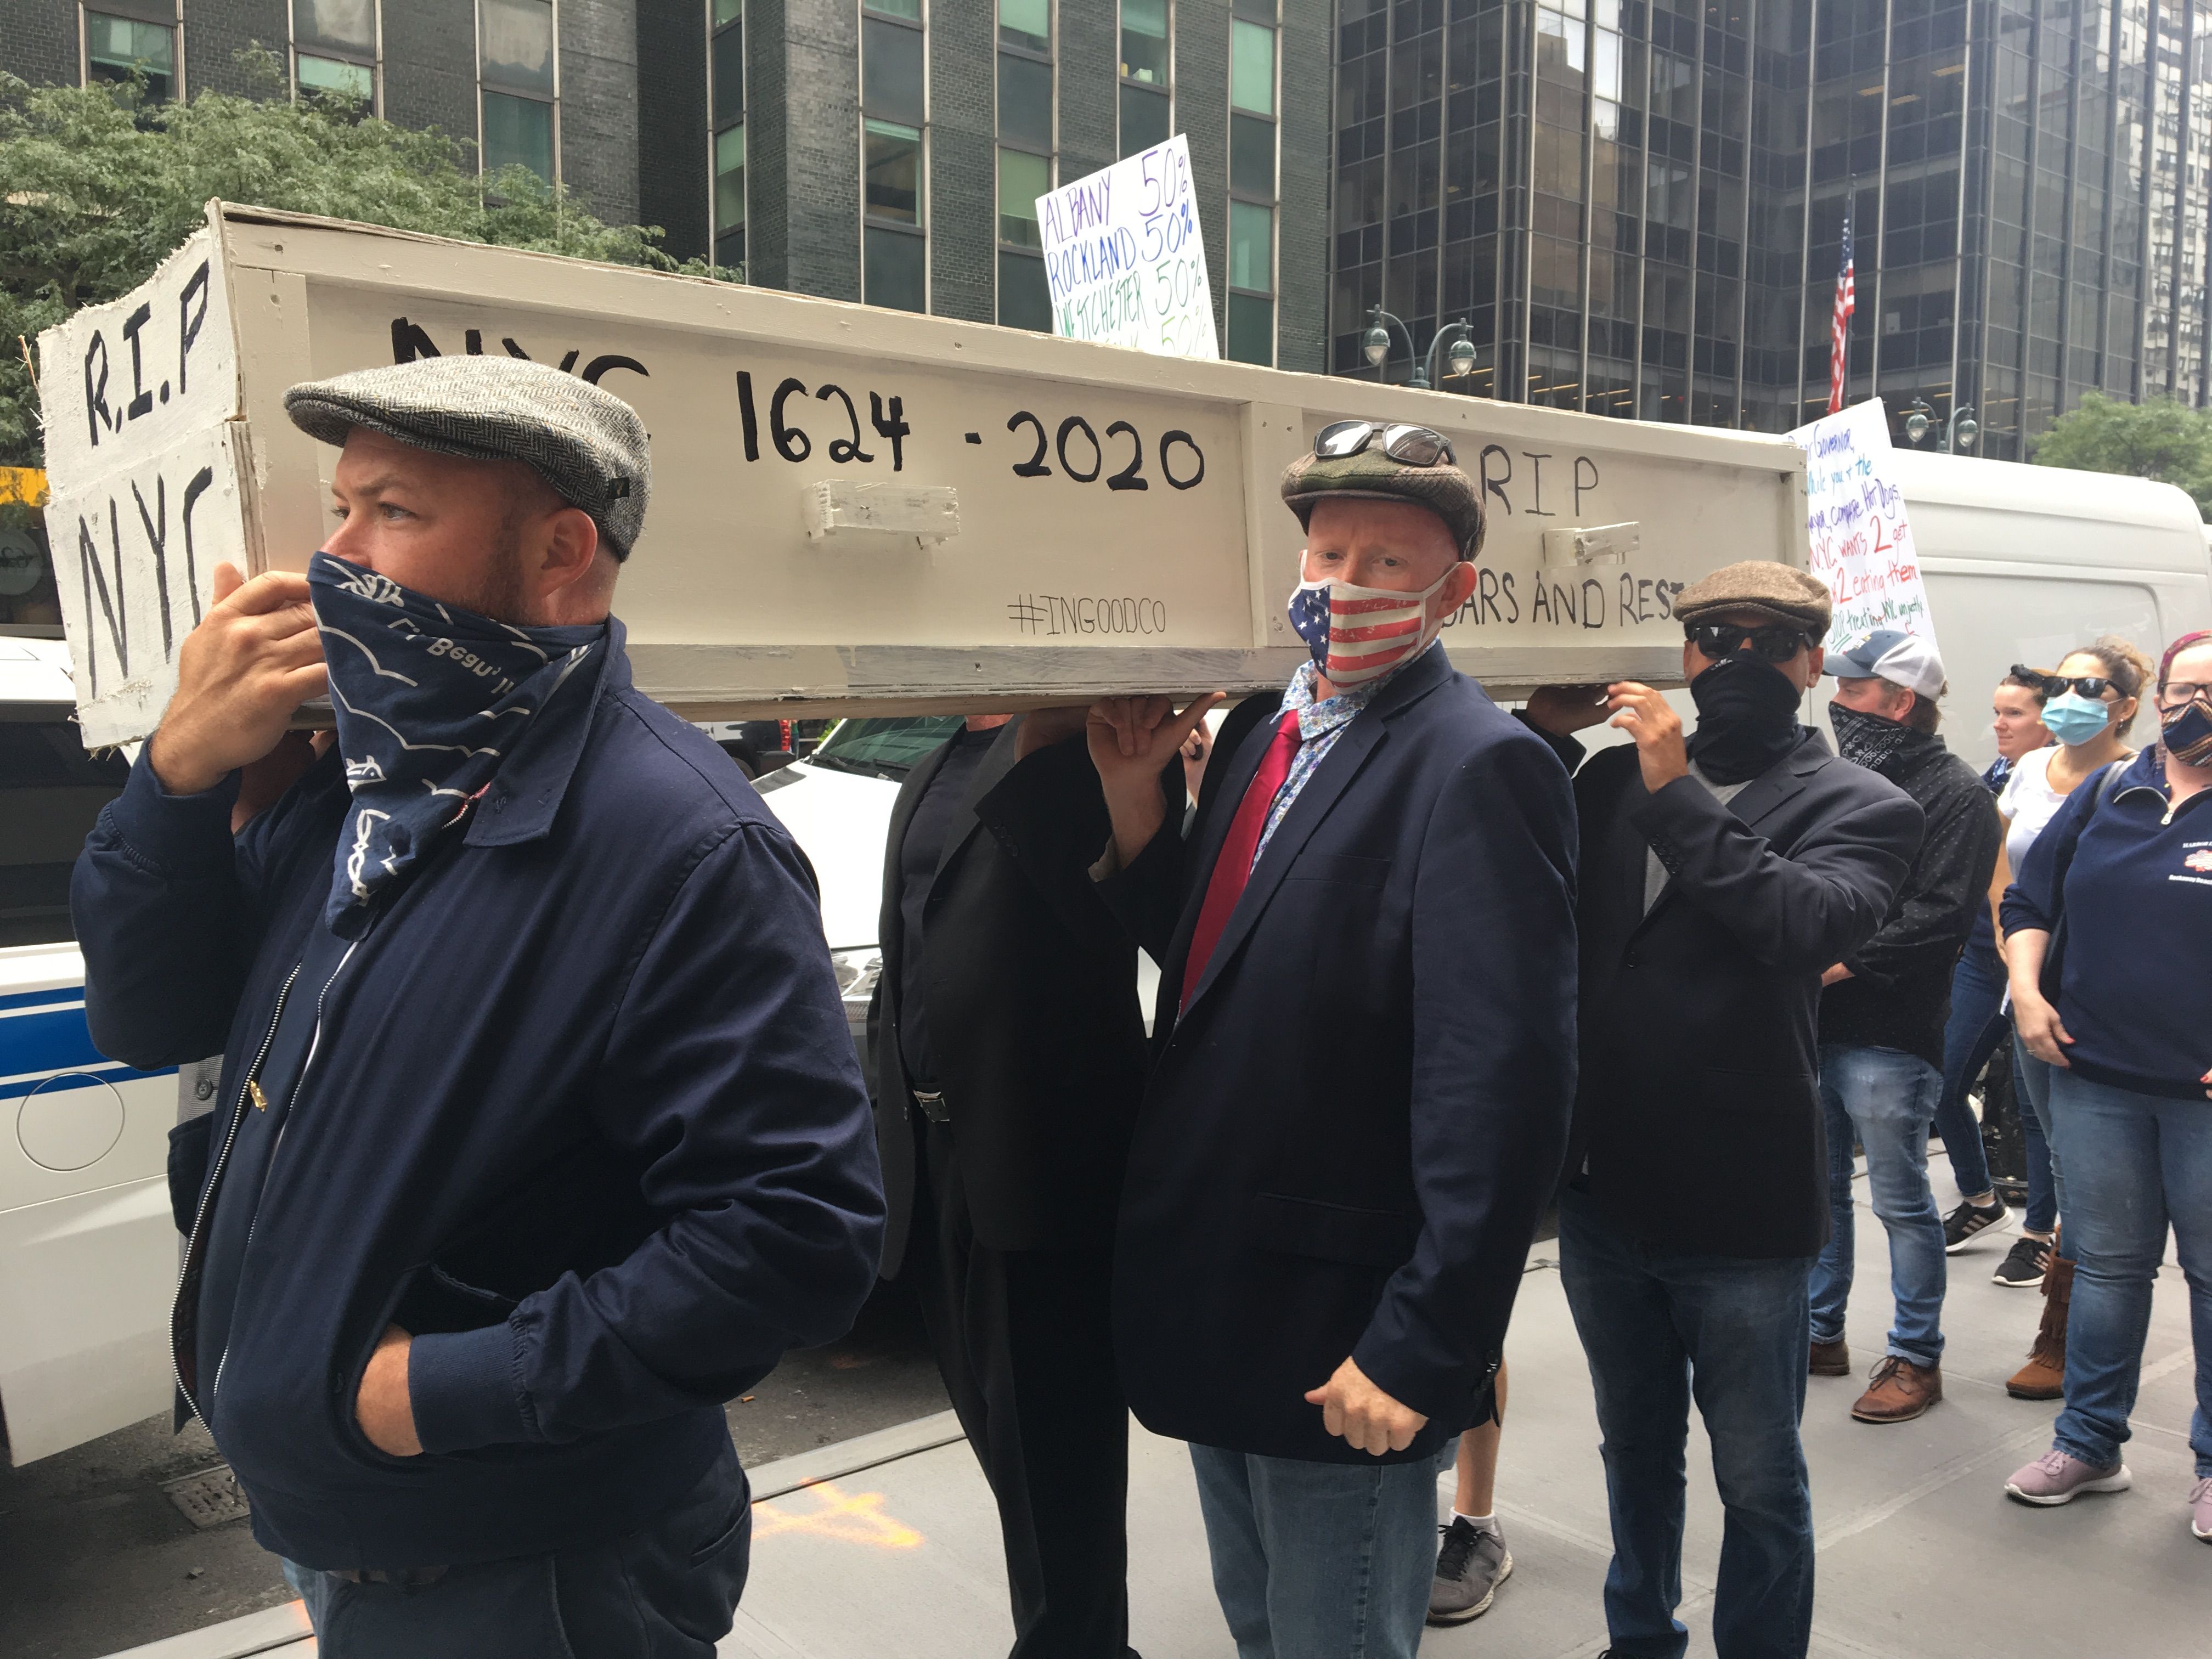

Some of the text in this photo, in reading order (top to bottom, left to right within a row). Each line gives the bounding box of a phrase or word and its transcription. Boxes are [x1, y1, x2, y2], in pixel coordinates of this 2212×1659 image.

[1045, 148, 1188, 250] ALBANY 50%
[1047, 199, 1193, 302] ROCKLAND 50%
[1056, 253, 1202, 340] WESTCHESTER 50%
[84, 258, 210, 449] R.I.P
[737, 371, 910, 472] 1624
[1007, 411, 1205, 490] 2020
[1479, 443, 1599, 517] RIP
[1855, 453, 1872, 477] the
[1838, 531, 1867, 558] WANTS
[1870, 515, 1893, 554] 2
[1893, 518, 1908, 567] get
[1007, 594, 1166, 635] #INGOODCO
[1532, 571, 1605, 629] AND
[1837, 567, 1853, 604] 2
[1853, 568, 1887, 602] eating
[1887, 560, 1919, 587] them
[1846, 606, 1886, 631] treating
[1881, 597, 1898, 623] NYC
